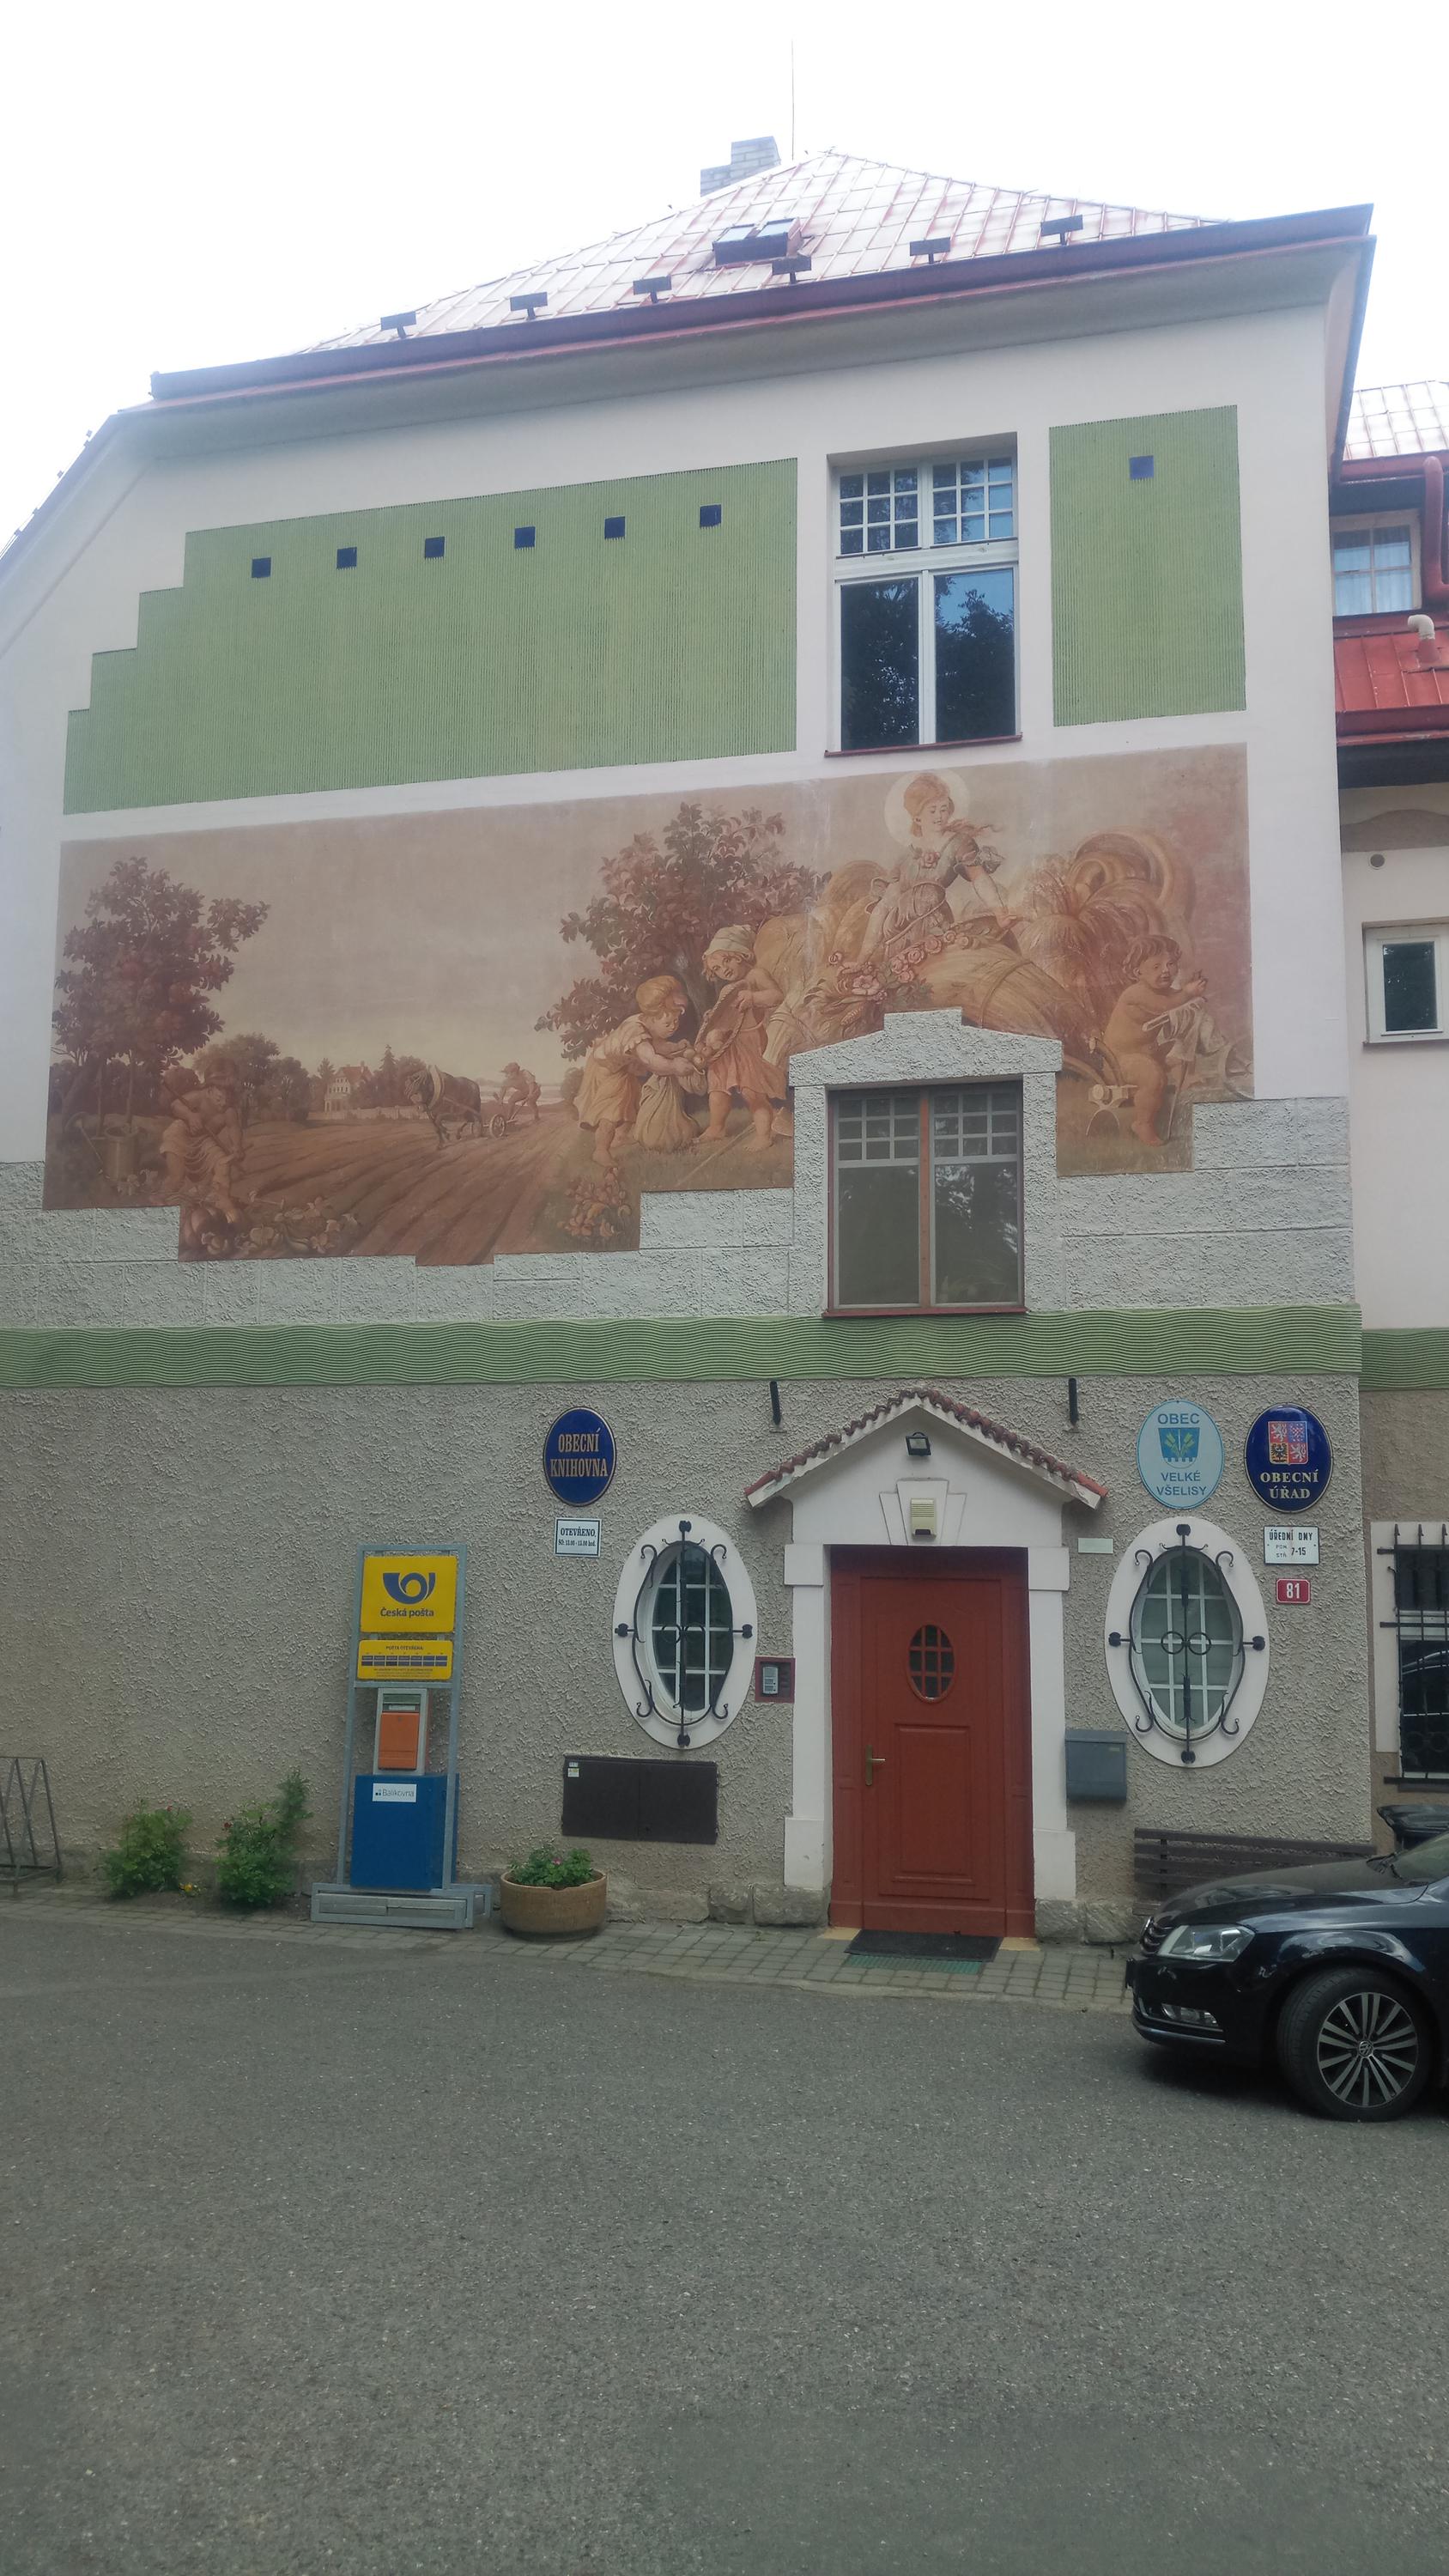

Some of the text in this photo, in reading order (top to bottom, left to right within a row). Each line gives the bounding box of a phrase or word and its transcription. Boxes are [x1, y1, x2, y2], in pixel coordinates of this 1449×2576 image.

[1157, 1413, 1200, 1425] OBEC
[558, 1428, 600, 1453] OBECNÍ
[549, 1458, 609, 1478] KNIHOVNA
[1161, 1470, 1201, 1482] VELKÉ
[1259, 1469, 1319, 1484] OBECNÍ
[1156, 1484, 1207, 1496] VŠELISY
[1269, 1485, 1311, 1499] ÚŘAD
[1269, 1528, 1313, 1540] ÚŘEDNÍ DNY
[1285, 1582, 1300, 1599] 81
[380, 1607, 434, 1619] Česká pošta
